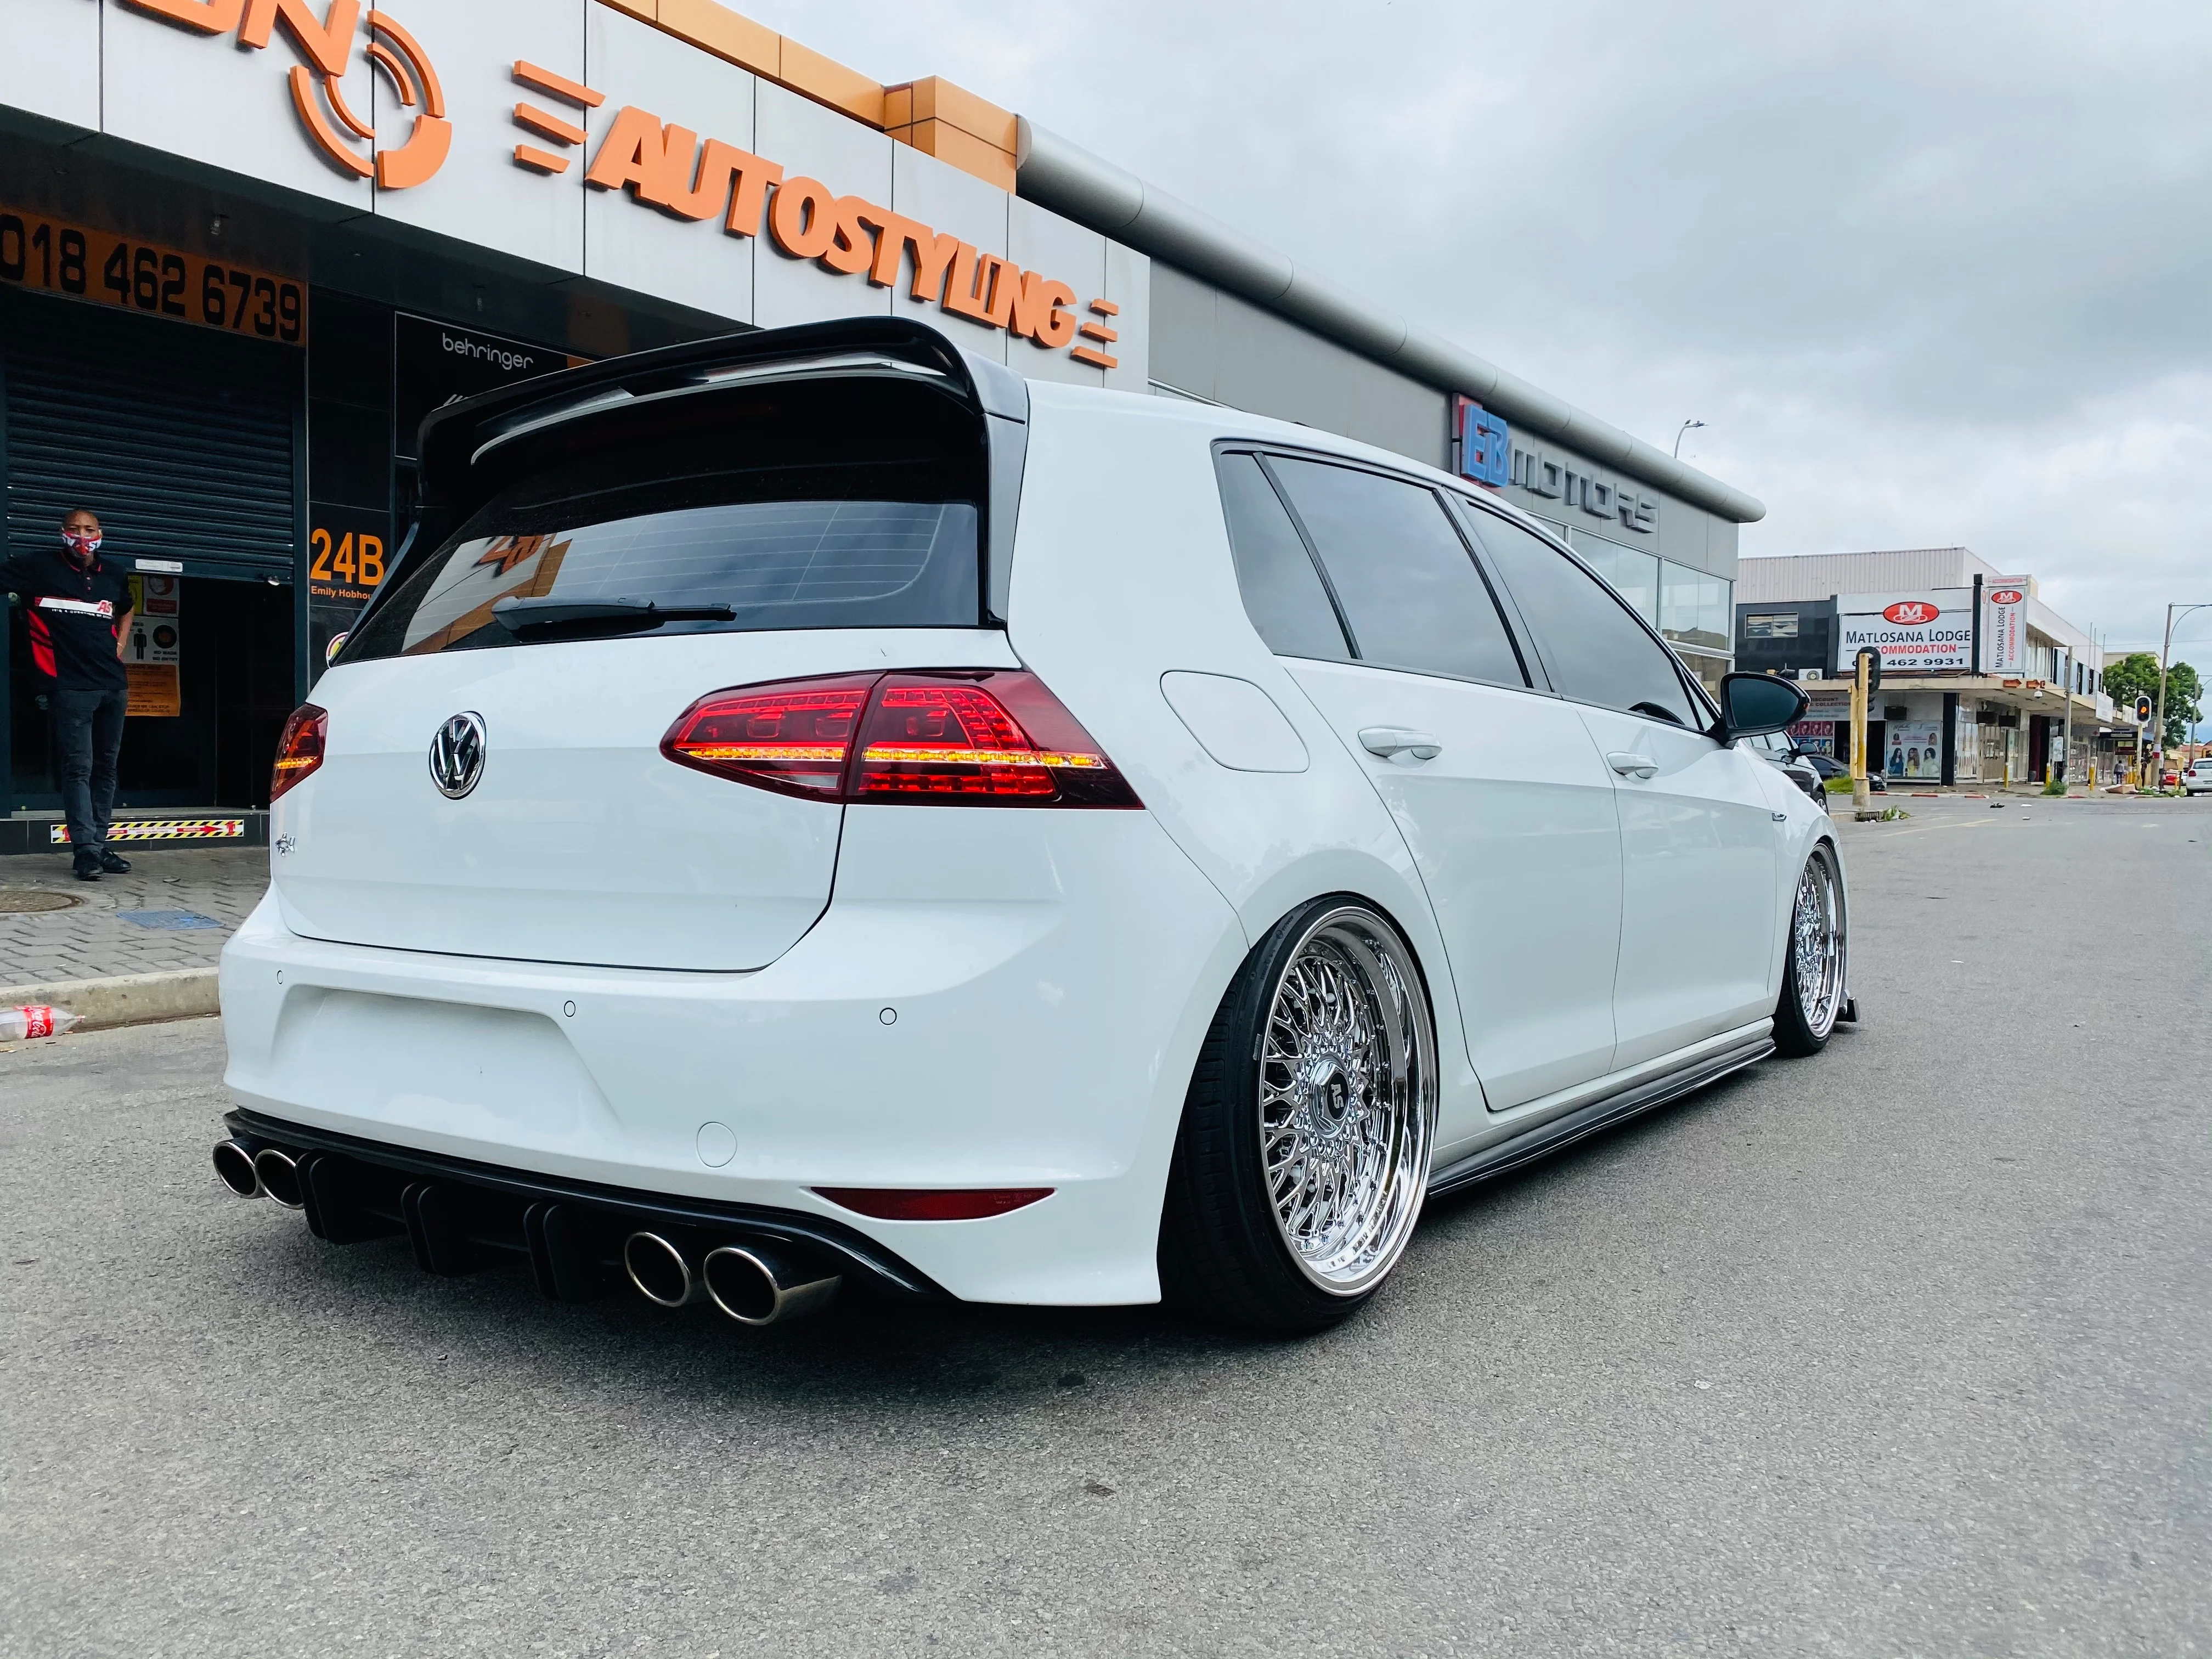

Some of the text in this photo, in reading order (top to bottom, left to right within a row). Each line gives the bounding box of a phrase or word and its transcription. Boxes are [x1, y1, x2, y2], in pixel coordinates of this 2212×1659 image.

[585, 105, 1076, 348] AUTOSTYLING
[0, 215, 301, 342] 018 462 6739
[442, 332, 533, 370] behringer
[310, 528, 384, 586] 24B
[311, 585, 337, 598] Emily
[1846, 629, 1971, 644] MATLOSANA LODGE
[1861, 644, 1957, 655] OMMODATION
[1995, 606, 2006, 668] MATLOSANA LODGE
[1331, 1084, 1344, 1109] AS
